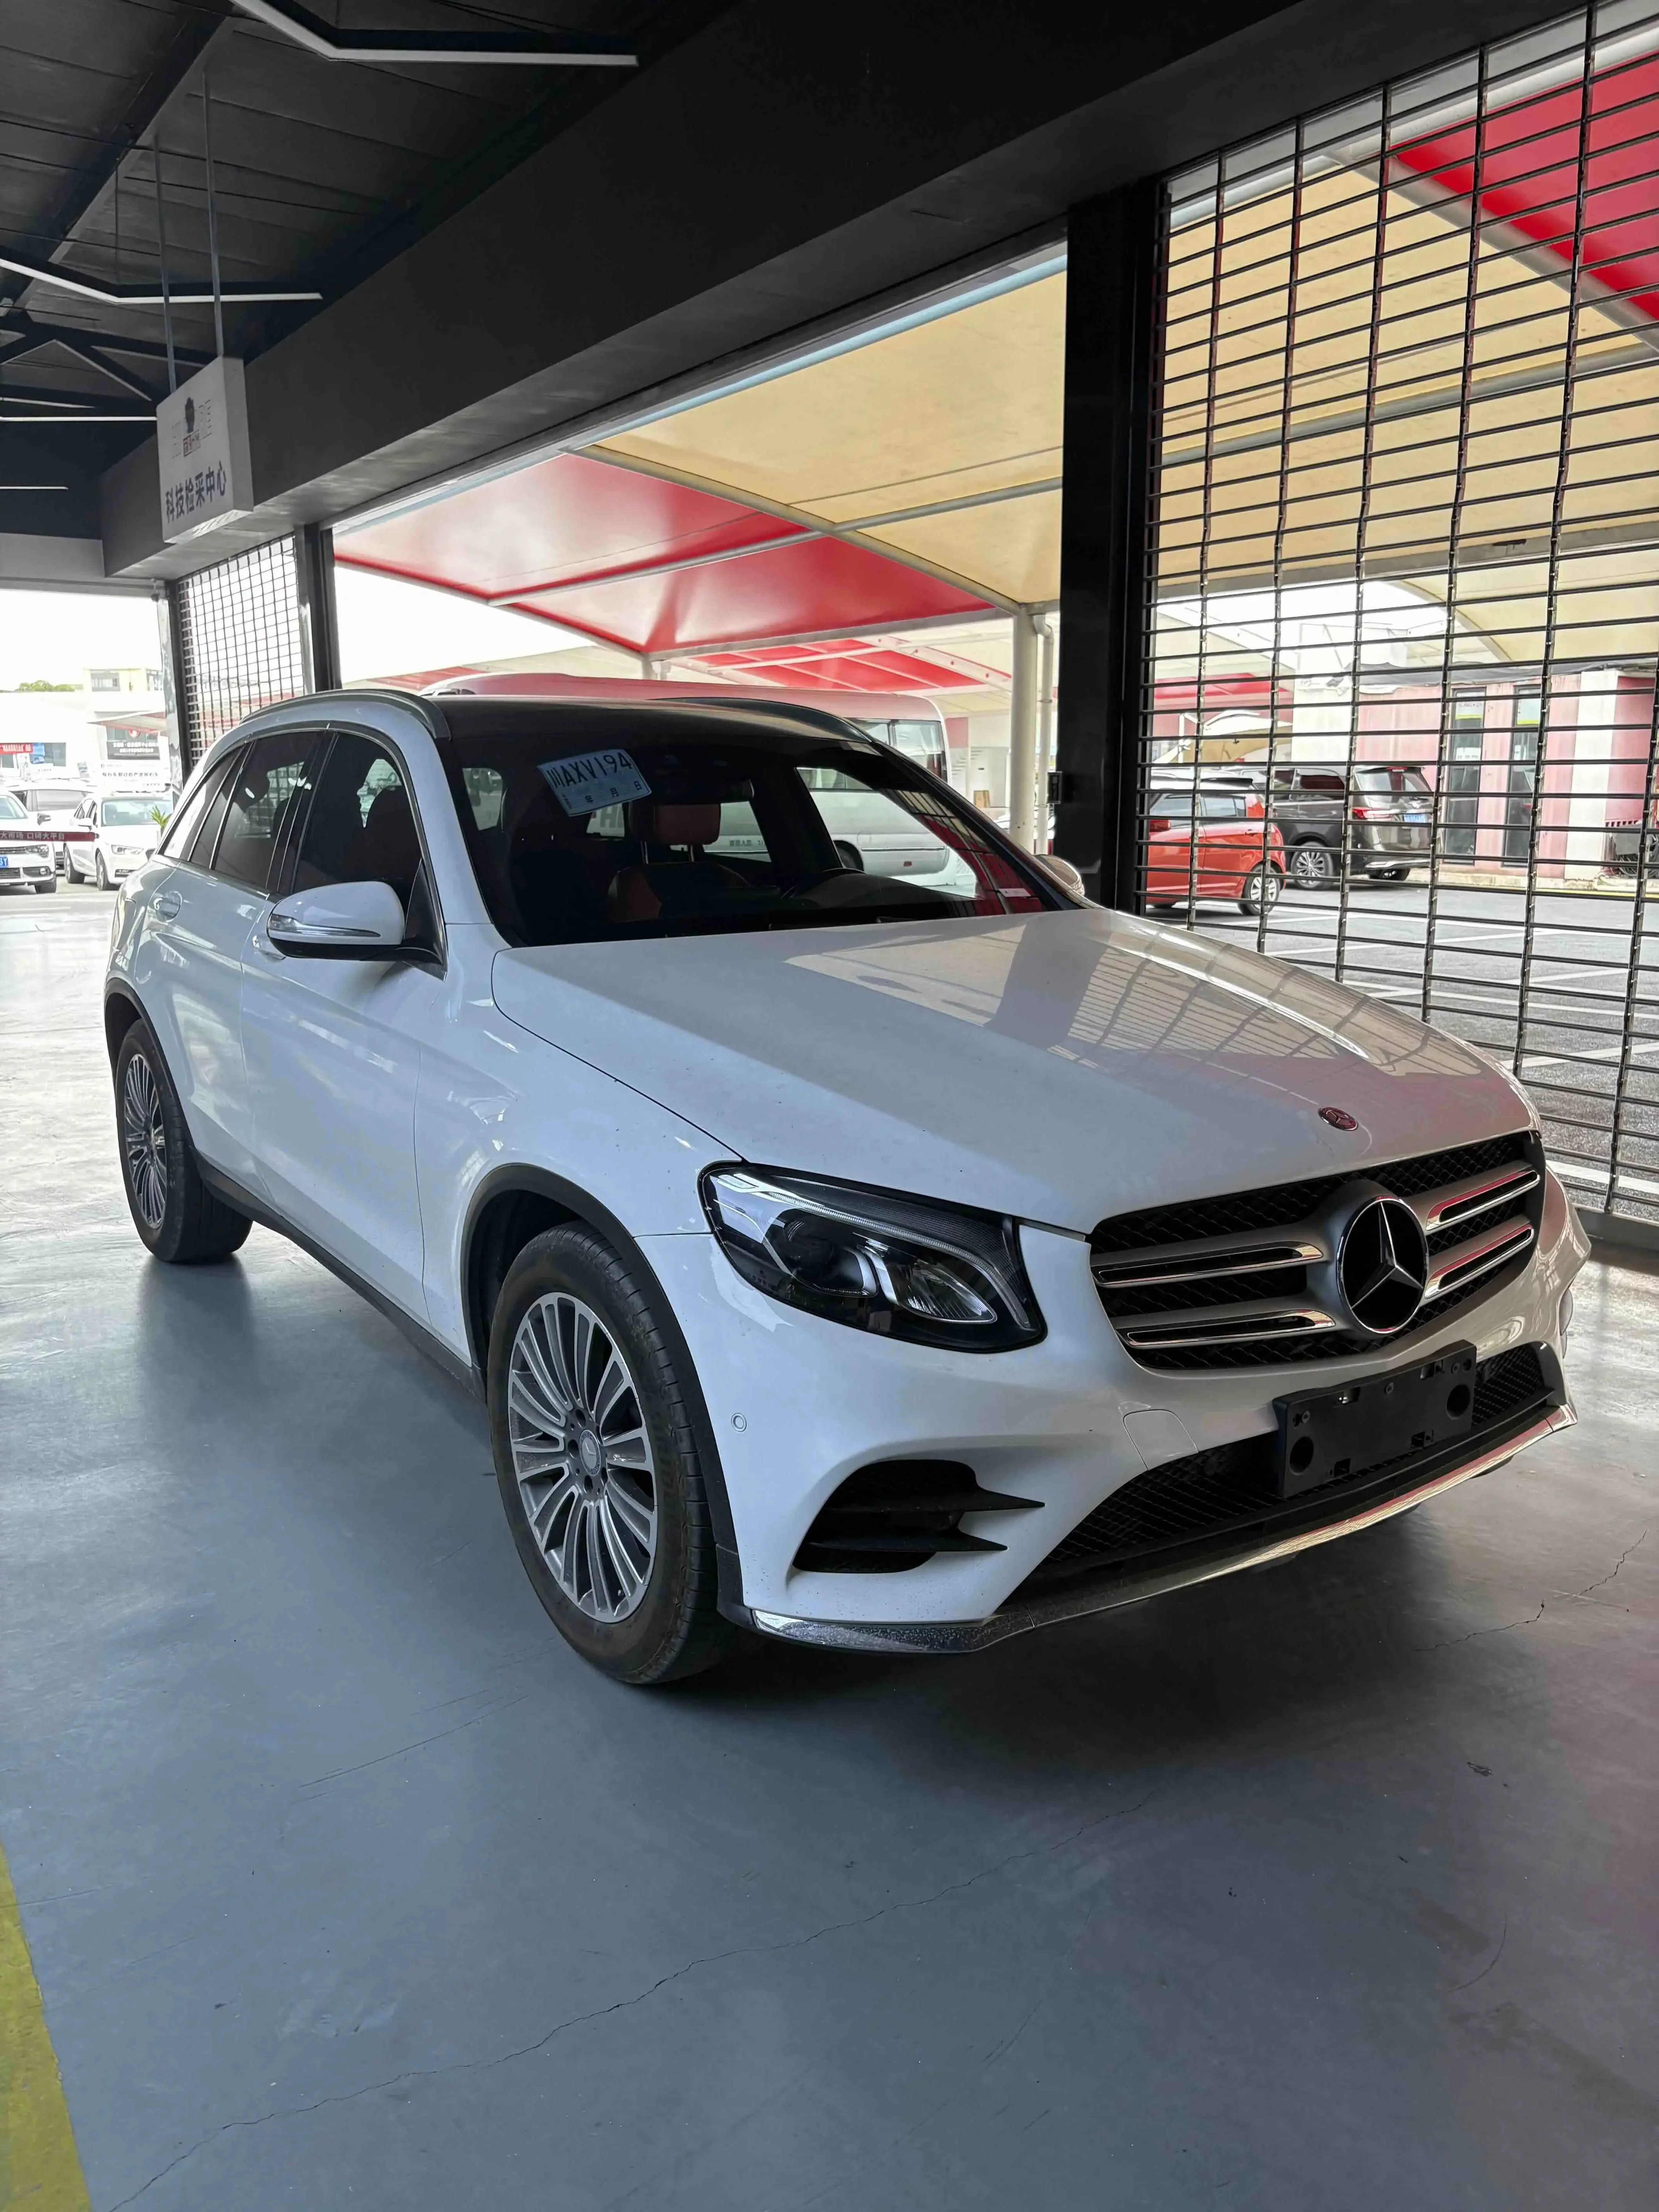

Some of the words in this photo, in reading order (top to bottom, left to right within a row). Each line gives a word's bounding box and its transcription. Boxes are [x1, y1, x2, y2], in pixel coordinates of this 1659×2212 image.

[166, 460, 227, 524] 科技检采中心
[585, 795, 594, 804] 年
[610, 788, 619, 798] 月
[634, 781, 642, 790] 日
